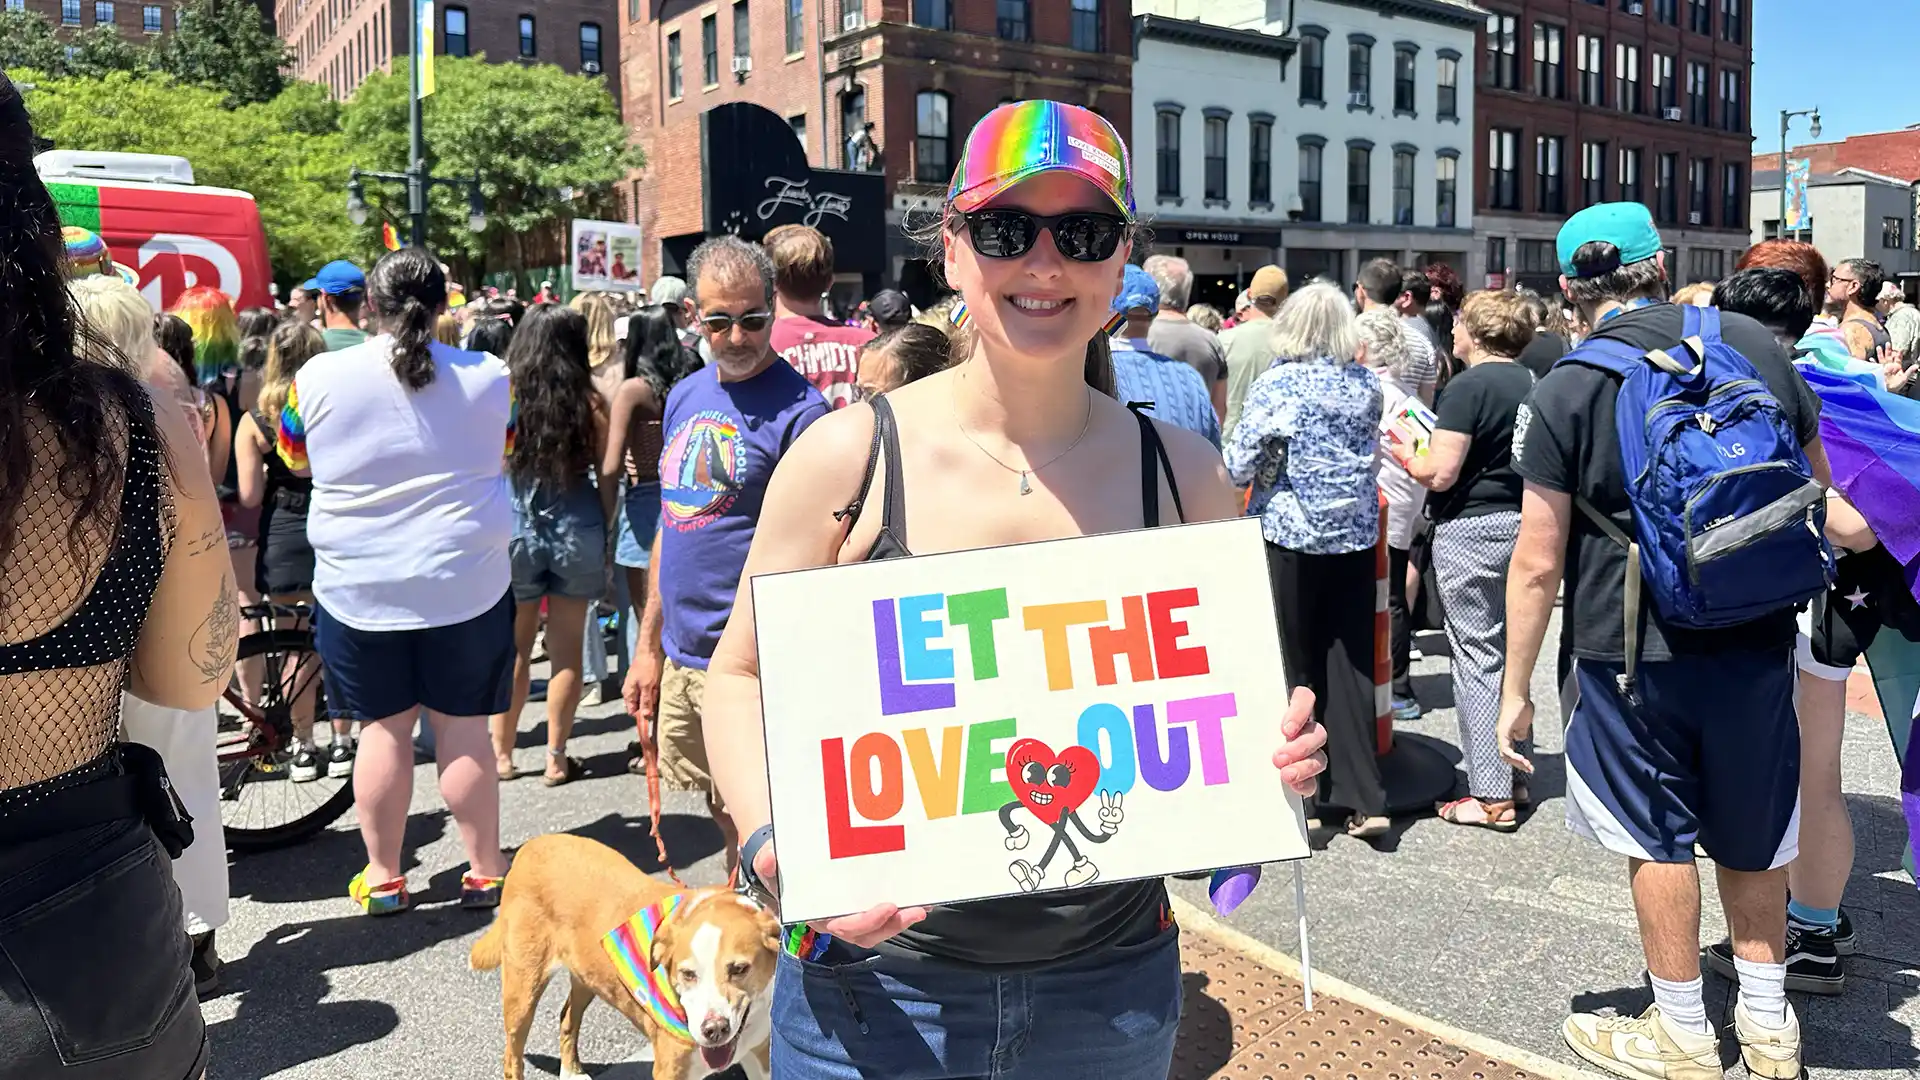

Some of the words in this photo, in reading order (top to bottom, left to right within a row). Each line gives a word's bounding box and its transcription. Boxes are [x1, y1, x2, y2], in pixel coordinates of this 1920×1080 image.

[1186, 232, 1209, 241] OPEN
[1211, 233, 1239, 242] HOUSE
[777, 342, 857, 375] CHMIDT
[873, 587, 1009, 715] LET
[1022, 587, 1210, 692] THE
[820, 717, 1017, 860] LOVE
[1077, 692, 1238, 797] OUT
